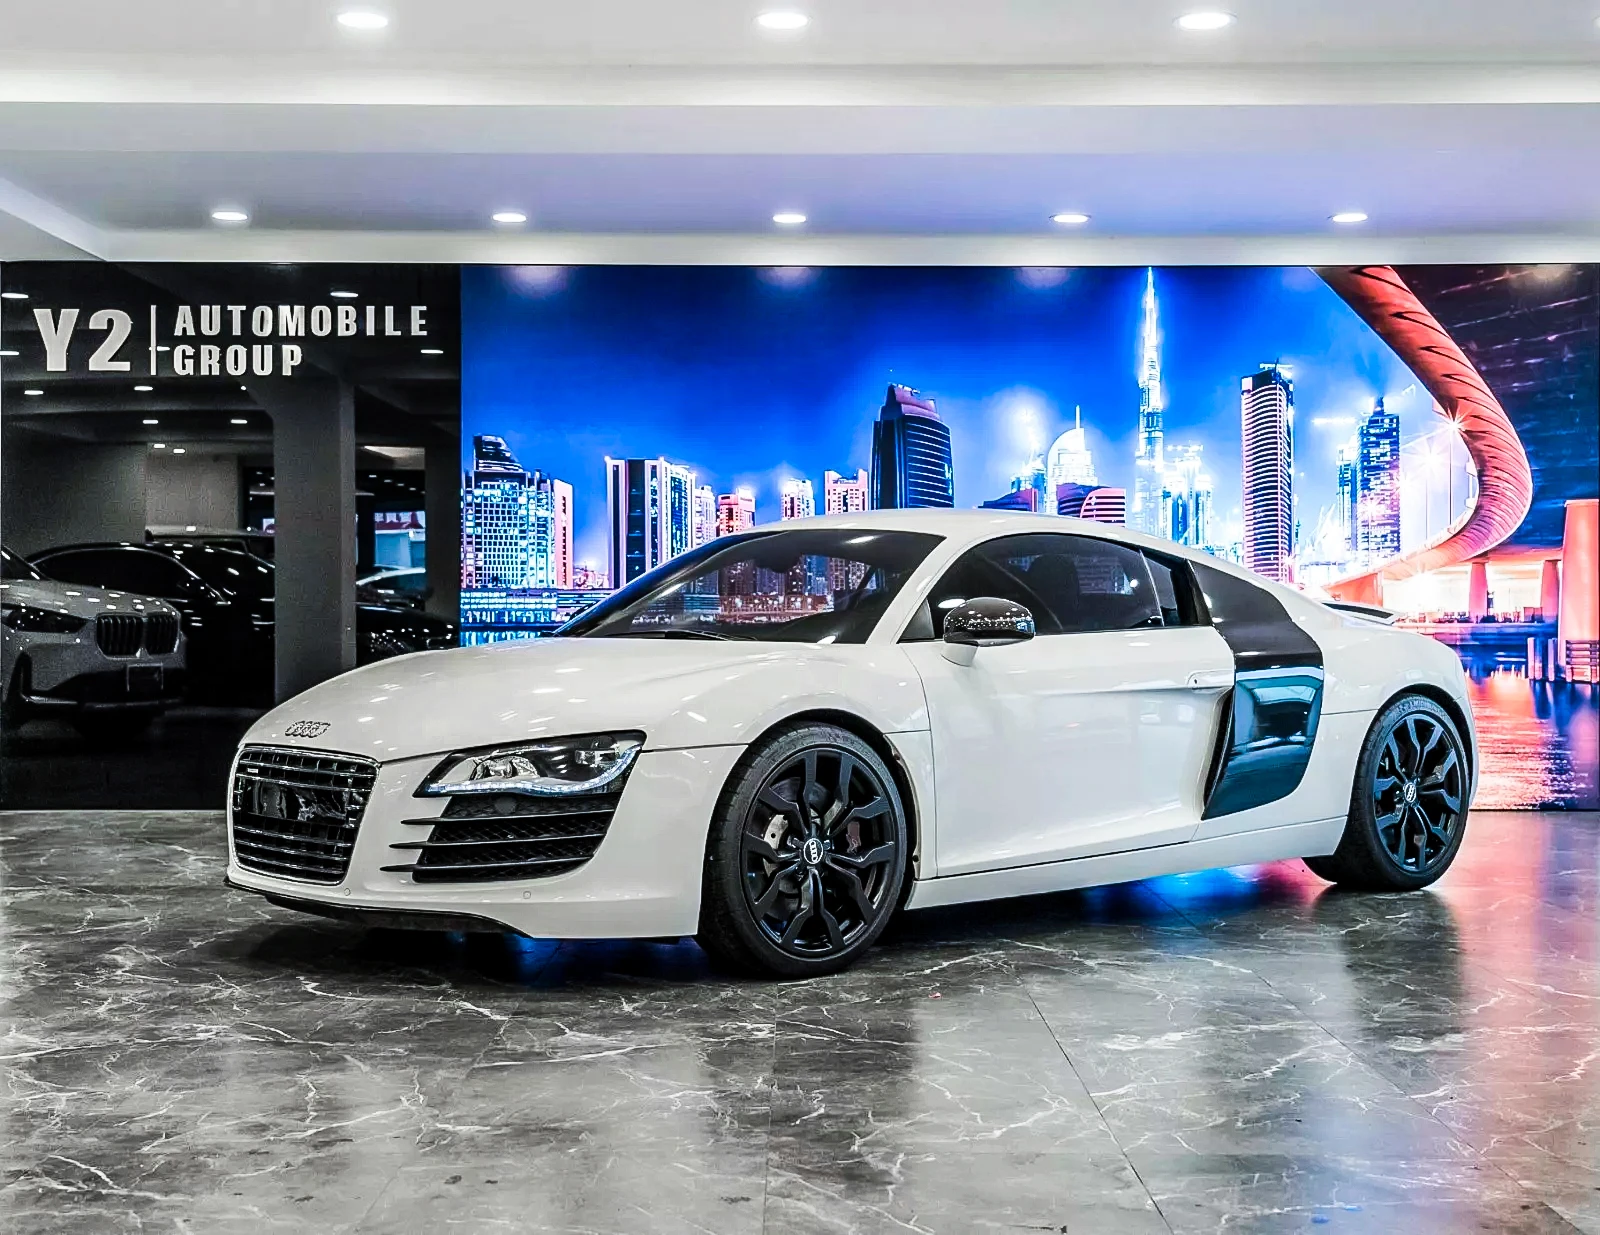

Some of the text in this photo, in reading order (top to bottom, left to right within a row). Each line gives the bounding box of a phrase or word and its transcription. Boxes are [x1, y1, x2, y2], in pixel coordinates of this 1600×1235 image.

[173, 304, 428, 337] AUTOMOBILE
[33, 308, 132, 372] Y2
[173, 344, 302, 376] GROUP
